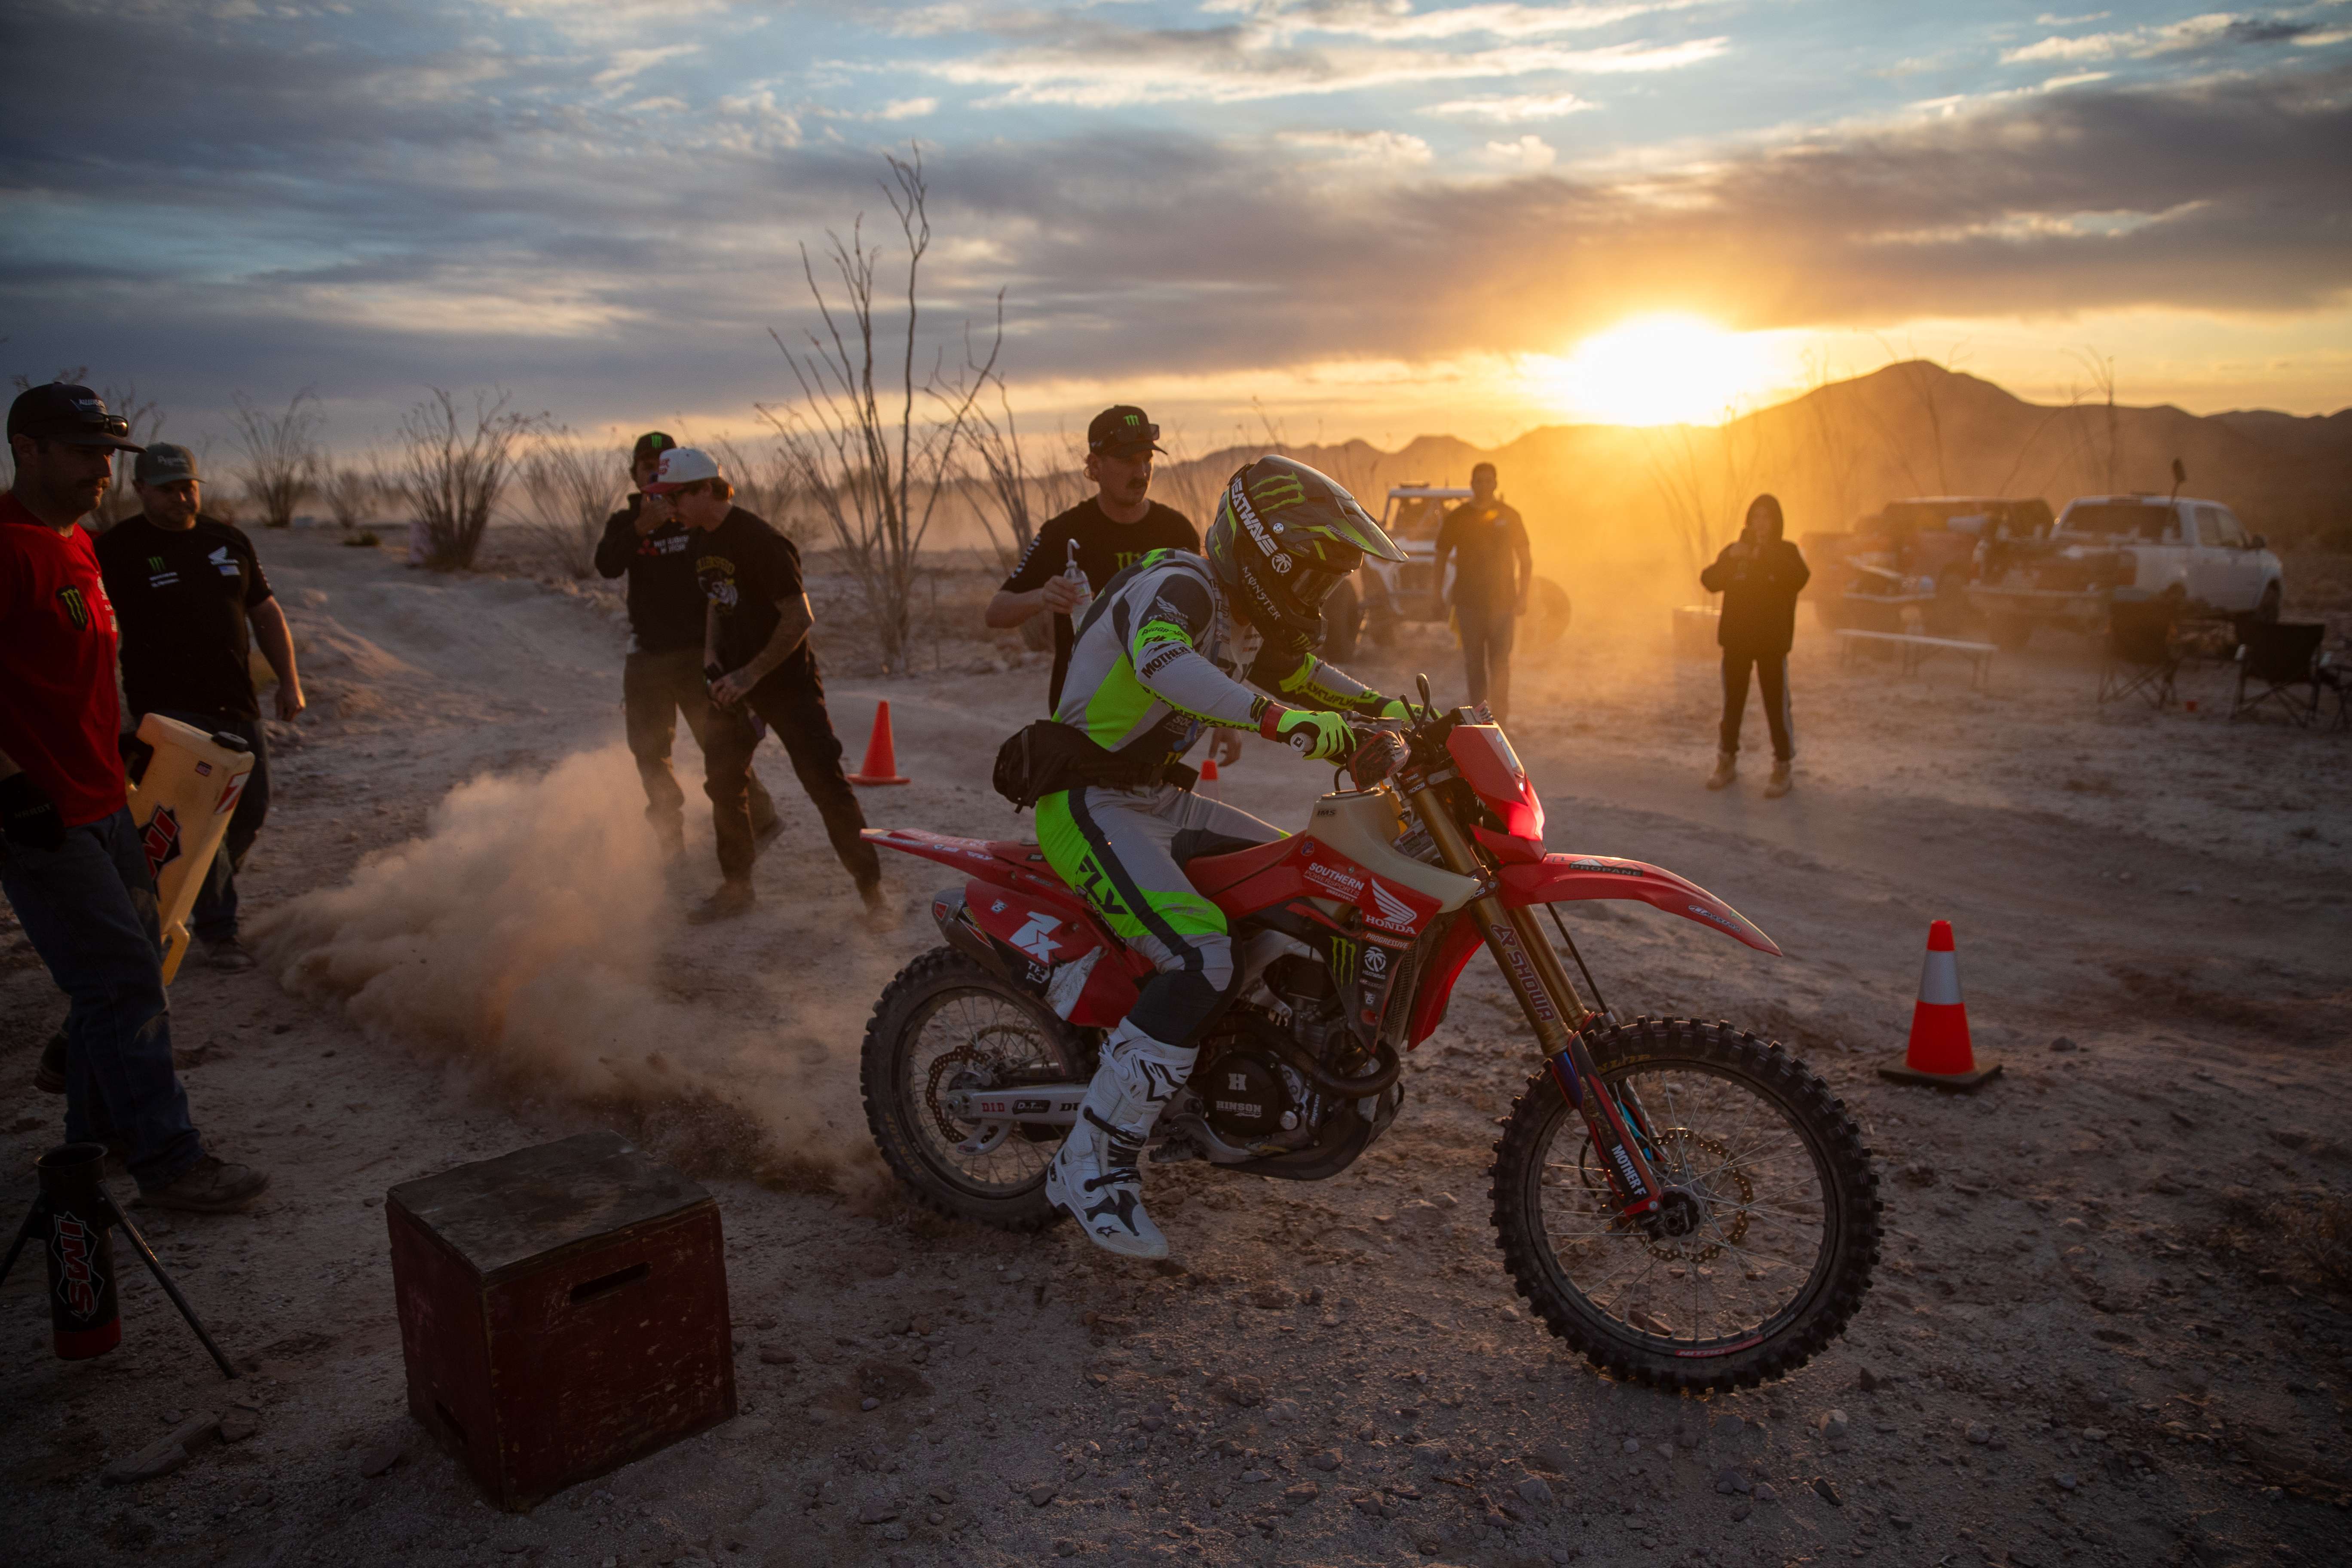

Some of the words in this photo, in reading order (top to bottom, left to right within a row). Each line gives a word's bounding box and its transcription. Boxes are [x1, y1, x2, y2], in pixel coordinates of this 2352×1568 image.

[1231, 476, 1279, 557] EATWAVE
[1303, 869, 1361, 897] POWERSPORTS
[1309, 862, 1365, 891] SOUTHERN
[1570, 864, 1642, 876] PROPANE
[1365, 914, 1417, 935] HONDA
[1366, 933, 1409, 949] PROGRESSIVE
[1505, 950, 1556, 1022] SHOWA
[1216, 1100, 1262, 1112] HINSON
[1611, 1144, 1642, 1190] MOTHER
[58, 1218, 95, 1314] IMS
